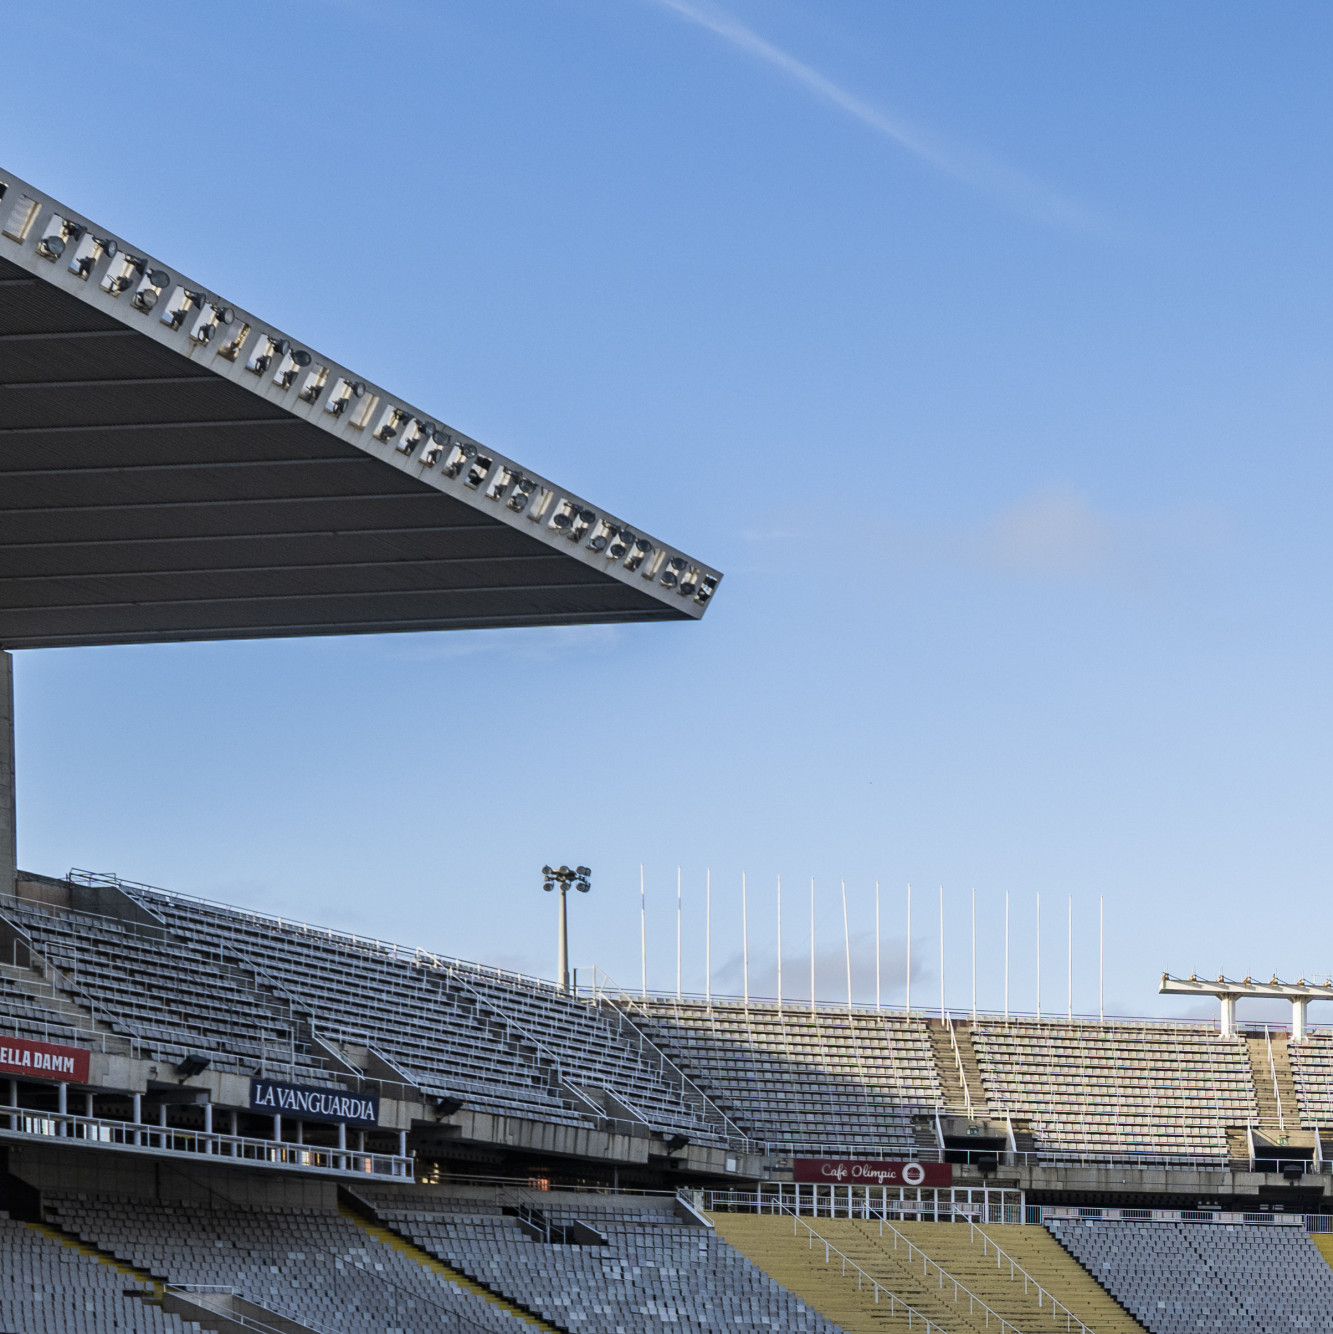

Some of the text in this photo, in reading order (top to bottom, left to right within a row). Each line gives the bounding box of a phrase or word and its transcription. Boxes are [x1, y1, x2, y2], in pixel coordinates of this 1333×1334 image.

[34, 1052, 74, 1073] DAMM
[255, 1085, 375, 1120] LA VANGUARDIA
